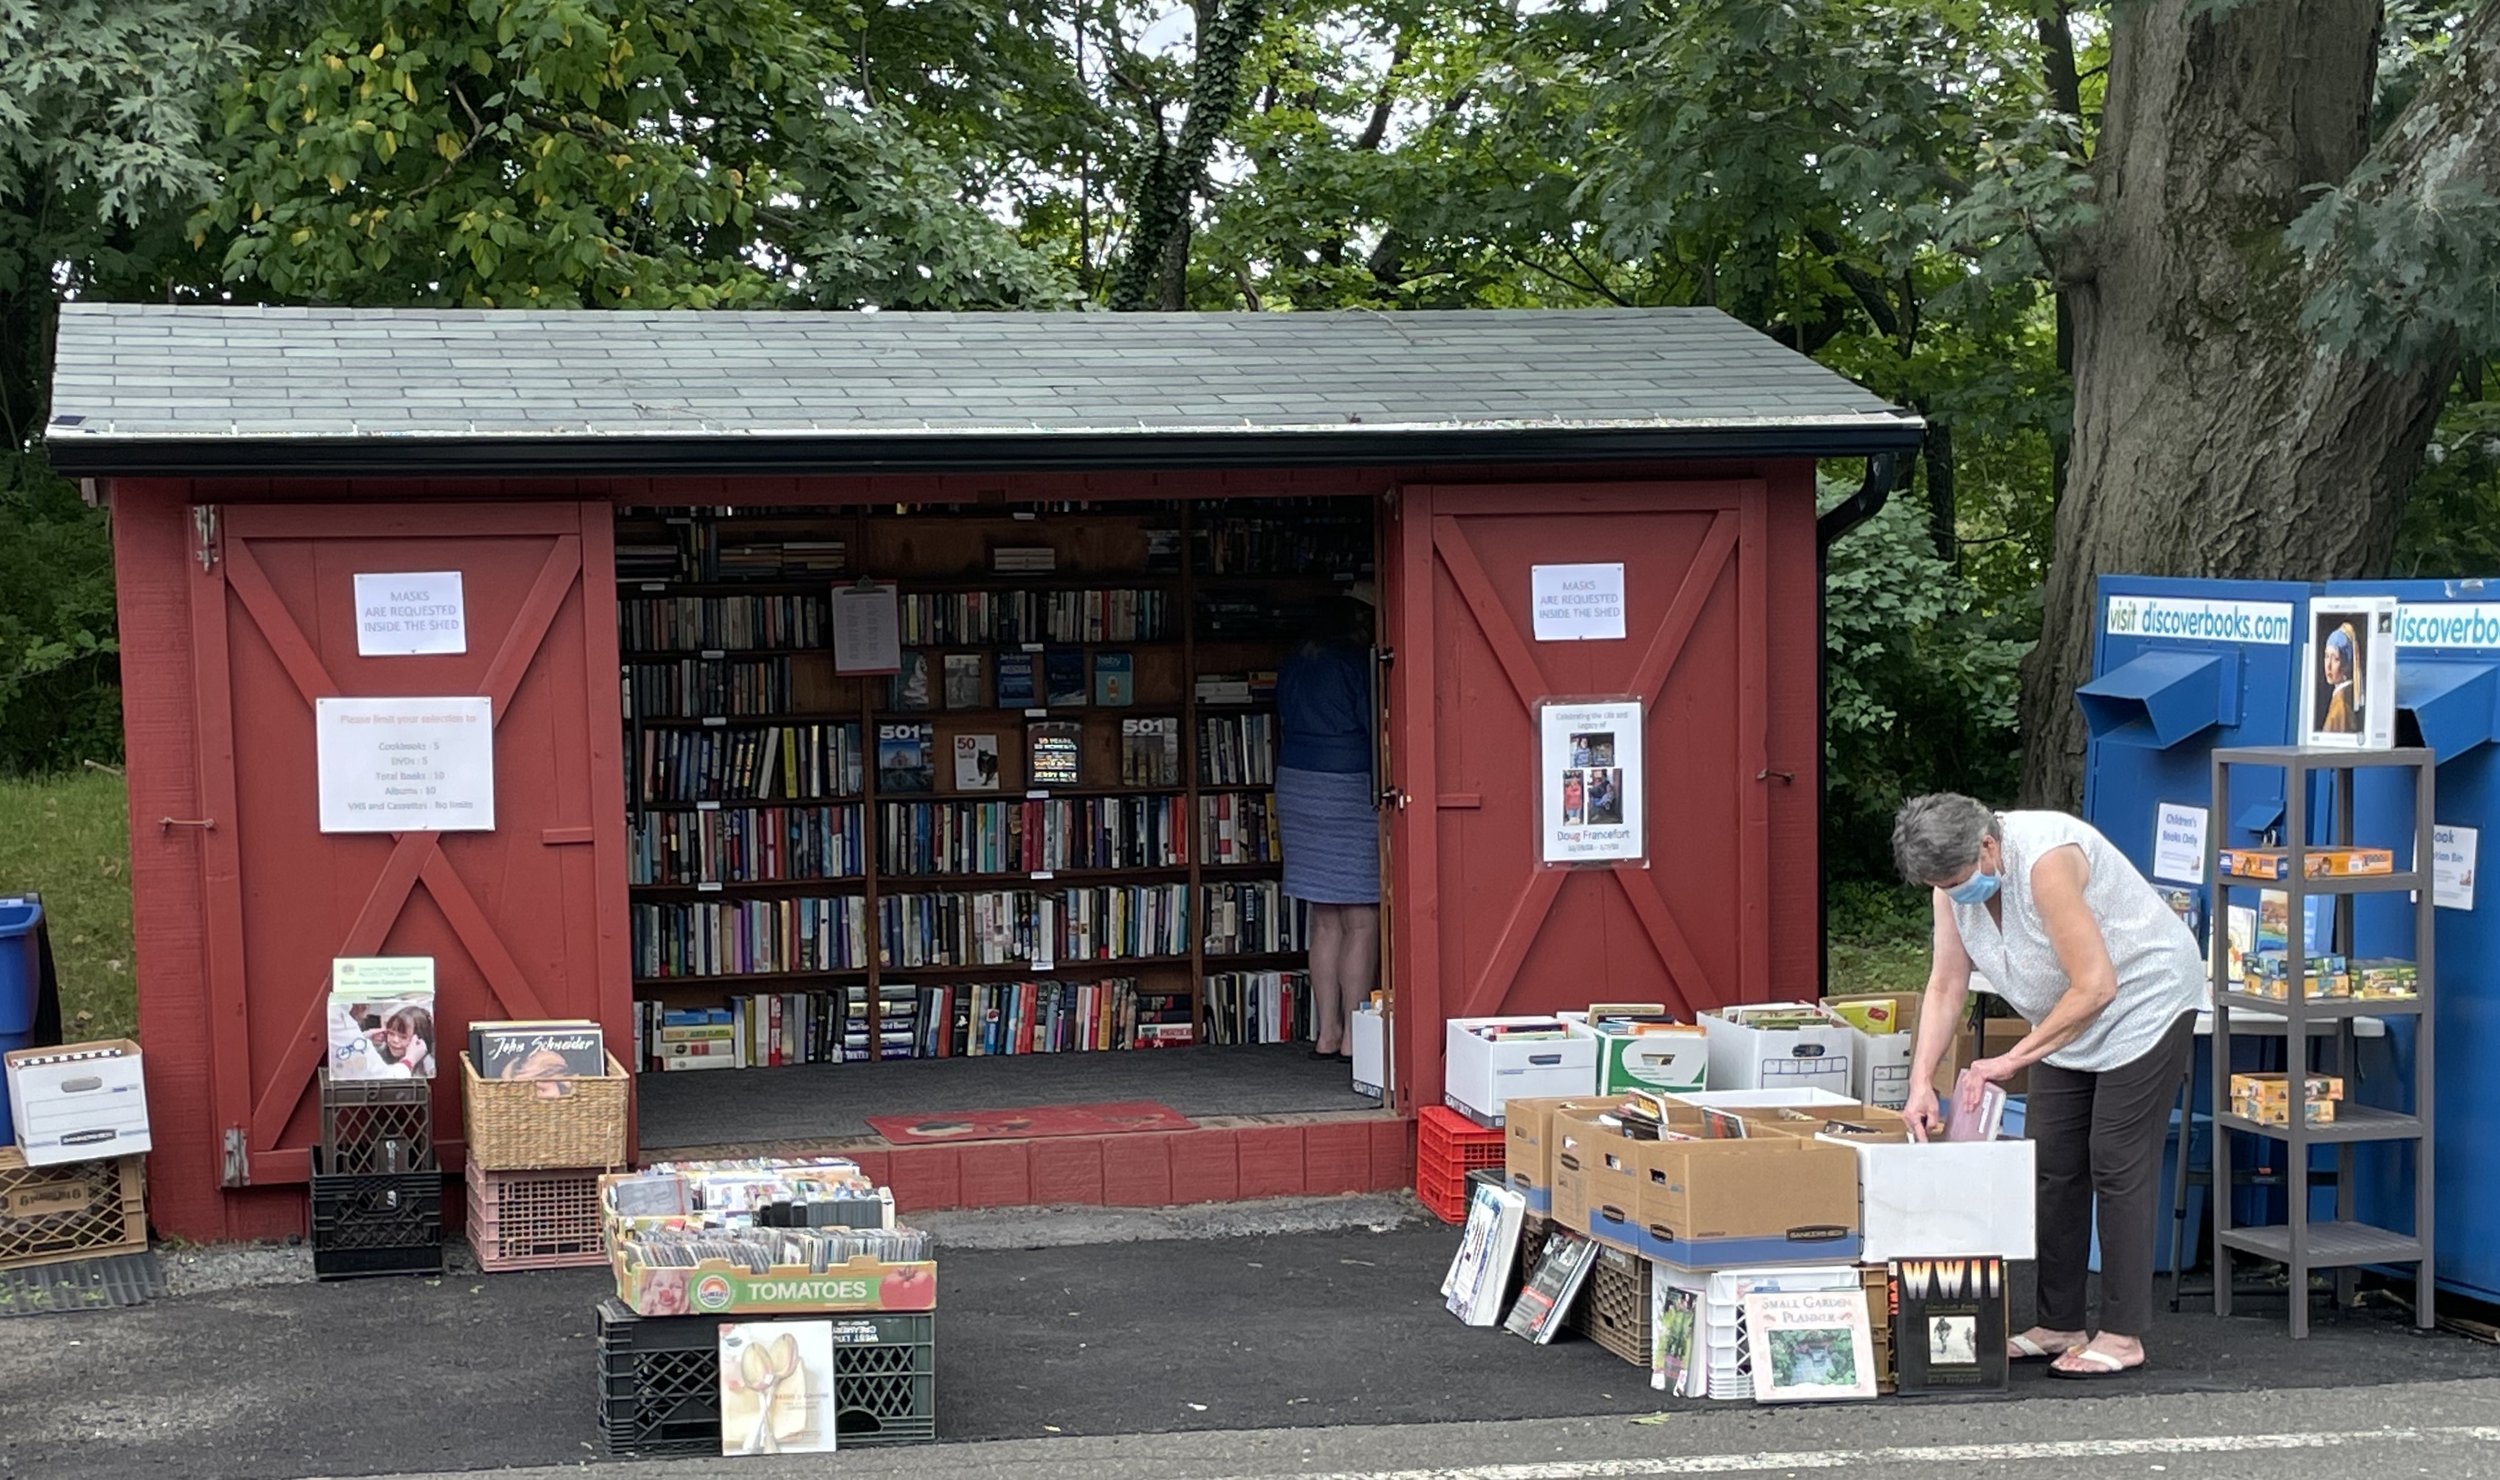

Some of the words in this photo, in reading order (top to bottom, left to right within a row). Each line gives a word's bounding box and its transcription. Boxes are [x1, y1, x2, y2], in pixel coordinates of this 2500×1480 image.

[1562, 581, 1596, 591] MASKS
[390, 591, 430, 602] MASKS
[1540, 595, 1559, 605] ARE
[1561, 593, 1619, 605] REQUESTED
[365, 606, 387, 618] ARE
[390, 605, 457, 618] REQUESTED
[1539, 608, 1571, 619] INSIDE
[1573, 608, 1592, 618] THE
[1594, 607, 1621, 617] SHED
[364, 622, 401, 633] INSIDE
[403, 620, 427, 631] THE
[429, 619, 460, 631] SHED
[2110, 600, 2137, 632] visit
[2142, 600, 2289, 641] discoverbooks.com
[2395, 606, 2500, 644] iscoverbo
[340, 714, 371, 725] Please
[373, 714, 395, 725] limit
[397, 716, 419, 725] your
[421, 714, 464, 724] selection
[465, 714, 477, 723] to
[1122, 719, 1164, 733] 501
[880, 725, 920, 740] 501
[378, 742, 427, 751] Cookbooks
[957, 738, 976, 750] 50
[391, 757, 416, 766] DVDs
[376, 772, 399, 781] Total
[400, 772, 427, 780] Books
[434, 772, 446, 780] 10
[385, 786, 419, 796] Albums
[426, 786, 437, 795] 10
[368, 802, 385, 810] and
[387, 802, 428, 811] Cassettes
[435, 801, 448, 810] No
[2165, 813, 2198, 828] Children's
[1557, 830, 1581, 843] Doug
[1582, 828, 1630, 841] Francefort
[2163, 830, 2181, 844] Books
[2183, 832, 2198, 848] Only
[2434, 829, 2455, 845] ook
[488, 1036, 526, 1061] John
[529, 1035, 595, 1058] Schneider
[1902, 1259, 1999, 1299] WWII
[747, 1280, 868, 1301] TOMATOES
